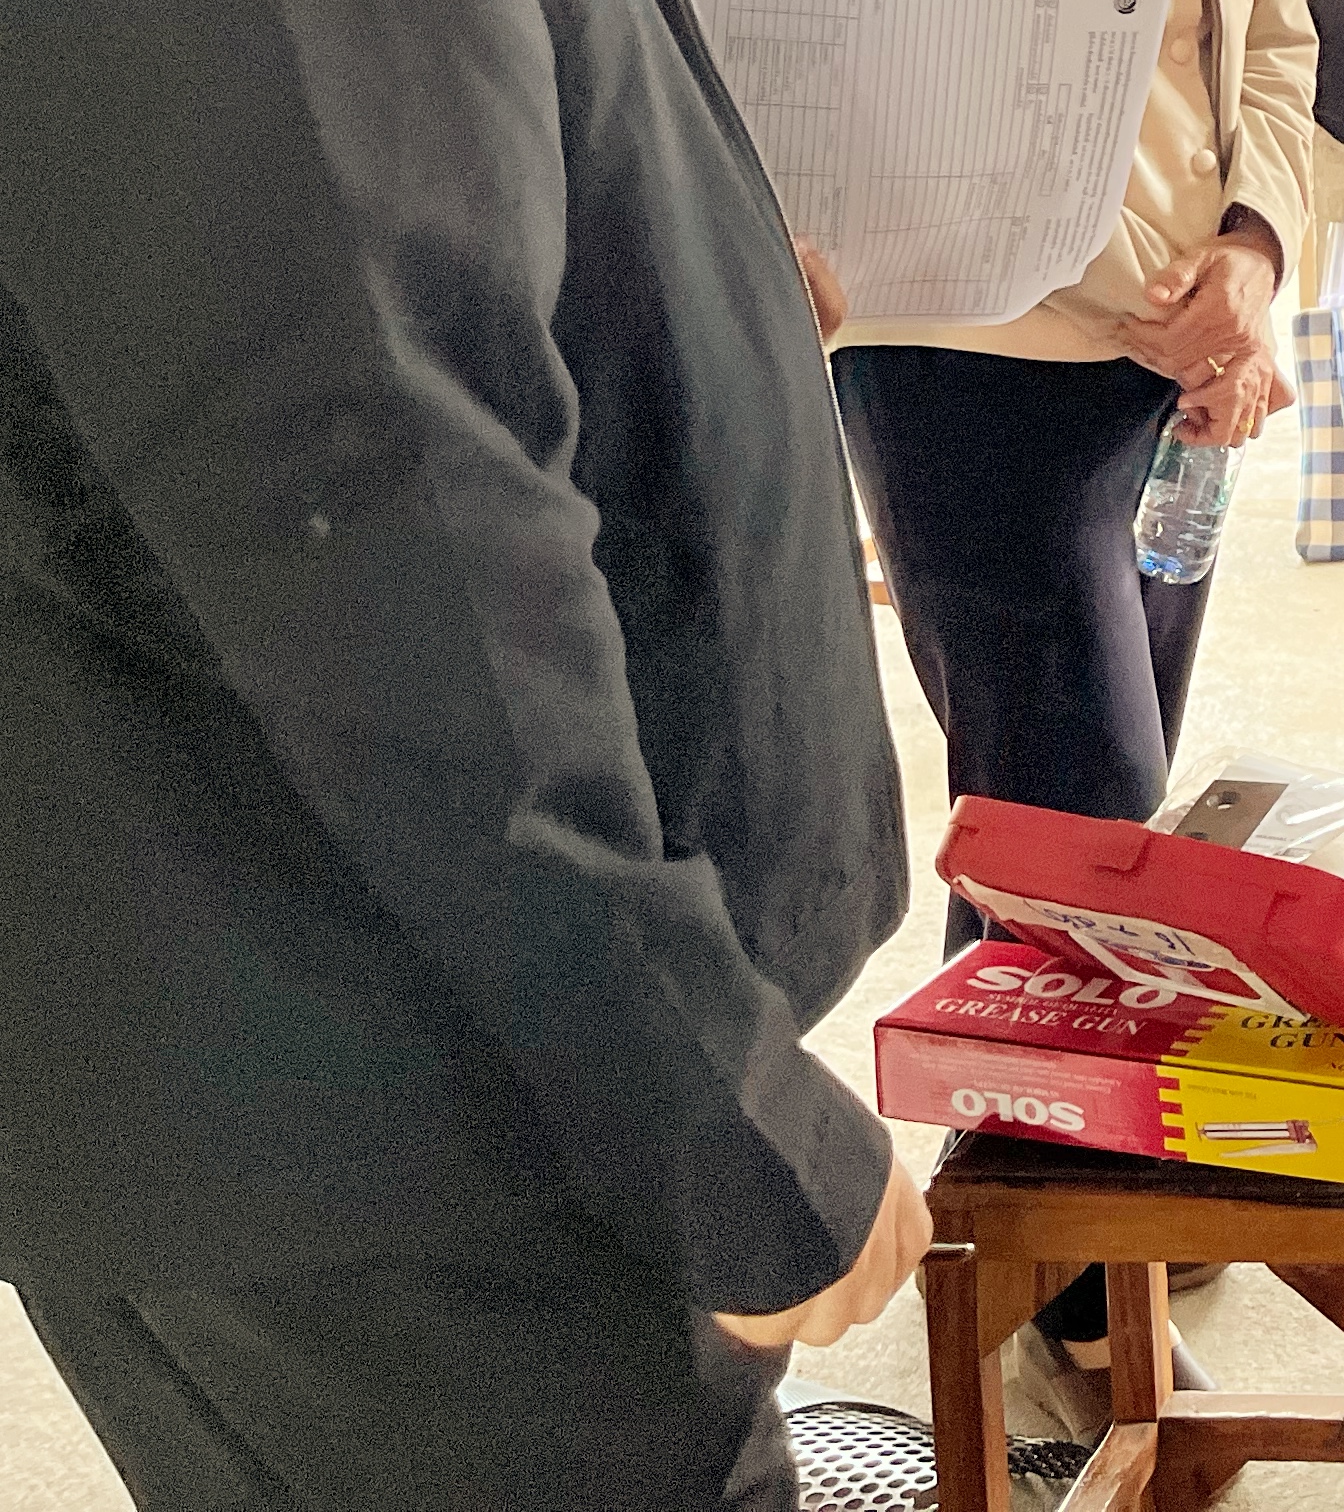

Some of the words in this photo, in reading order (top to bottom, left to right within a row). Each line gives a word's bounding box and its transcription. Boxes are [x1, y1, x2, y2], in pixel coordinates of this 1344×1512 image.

[966, 965, 1178, 1009] SOLO
[935, 998, 1067, 1026] GREASE
[1071, 1014, 1147, 1036] GUN
[951, 1088, 1086, 1132] SOLO
